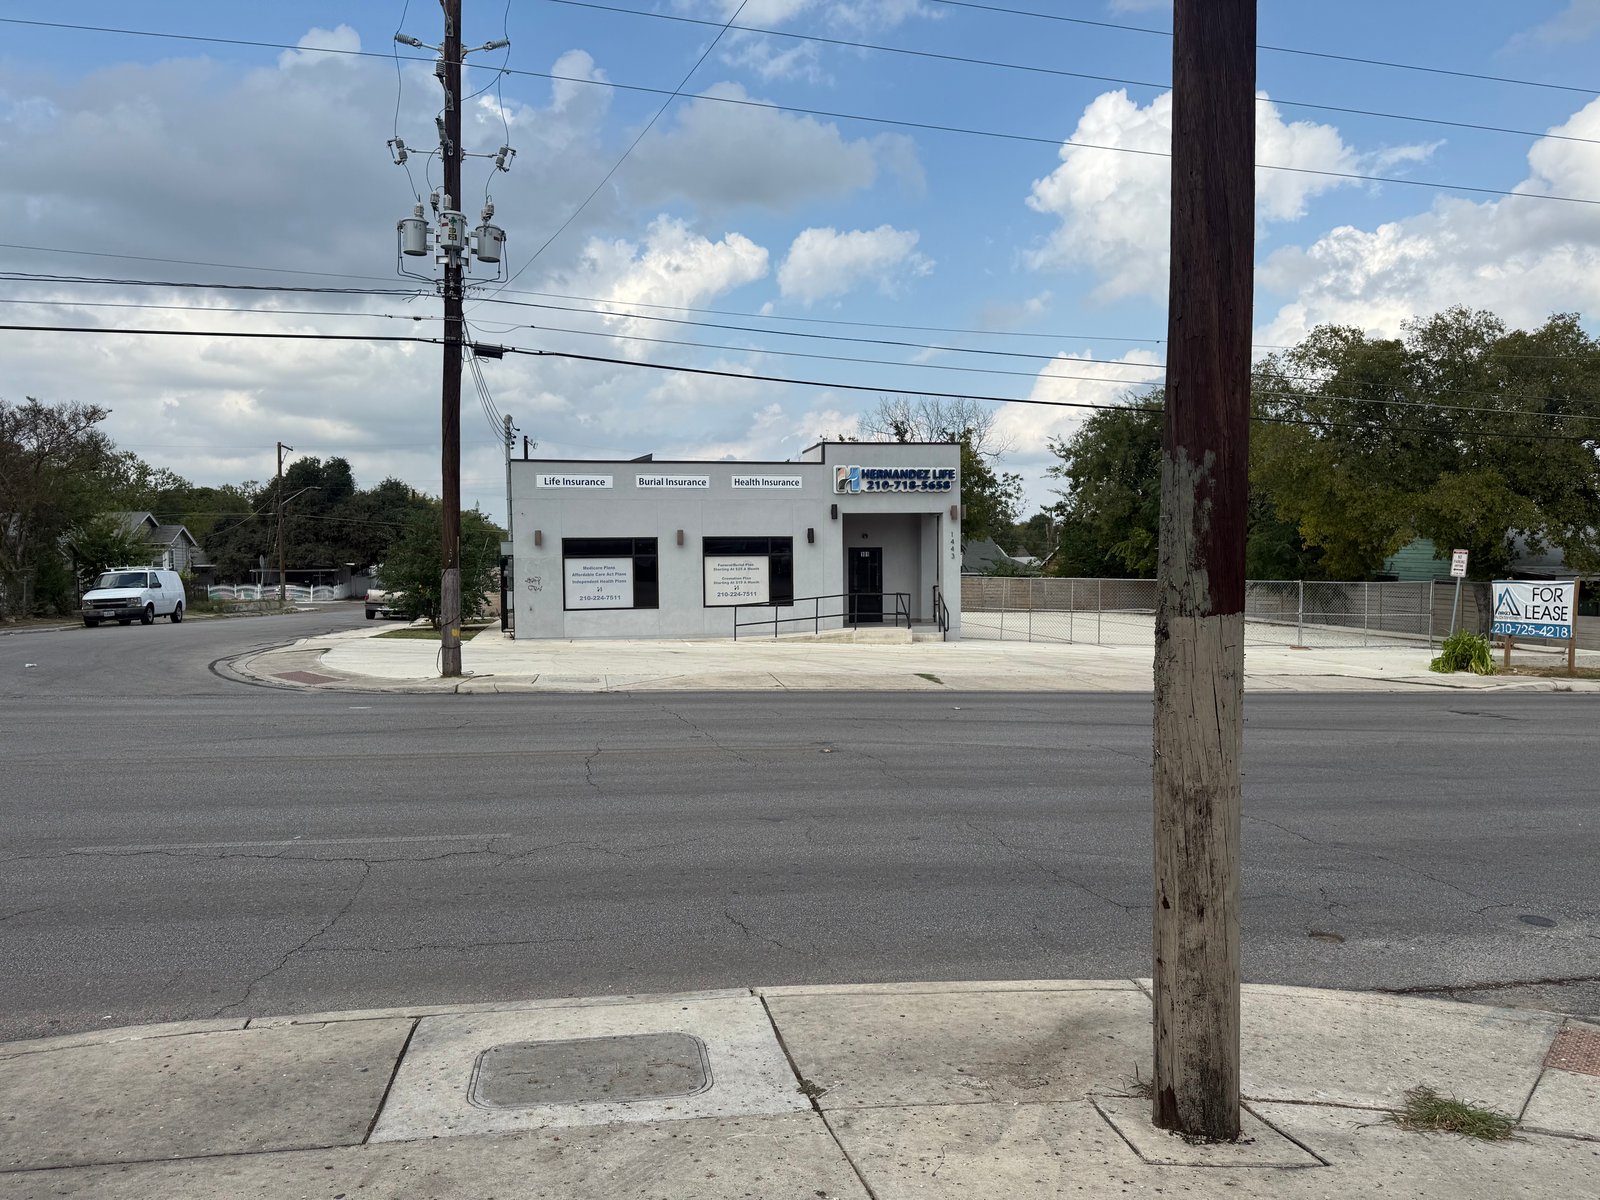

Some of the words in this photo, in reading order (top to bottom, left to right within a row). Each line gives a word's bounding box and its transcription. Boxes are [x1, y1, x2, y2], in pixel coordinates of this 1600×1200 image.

[861, 469, 930, 480] HERNANDEZ
[932, 469, 956, 480] LIFE
[544, 477, 560, 486] Life
[562, 478, 606, 486] Insurance
[638, 478, 664, 486] Burial
[666, 478, 706, 486] Insurance
[866, 480, 950, 490] 210-718-5658
[1532, 587, 1563, 602] FOR
[1524, 605, 1568, 621] LEASE
[1494, 623, 1568, 638] 210-725-4218
